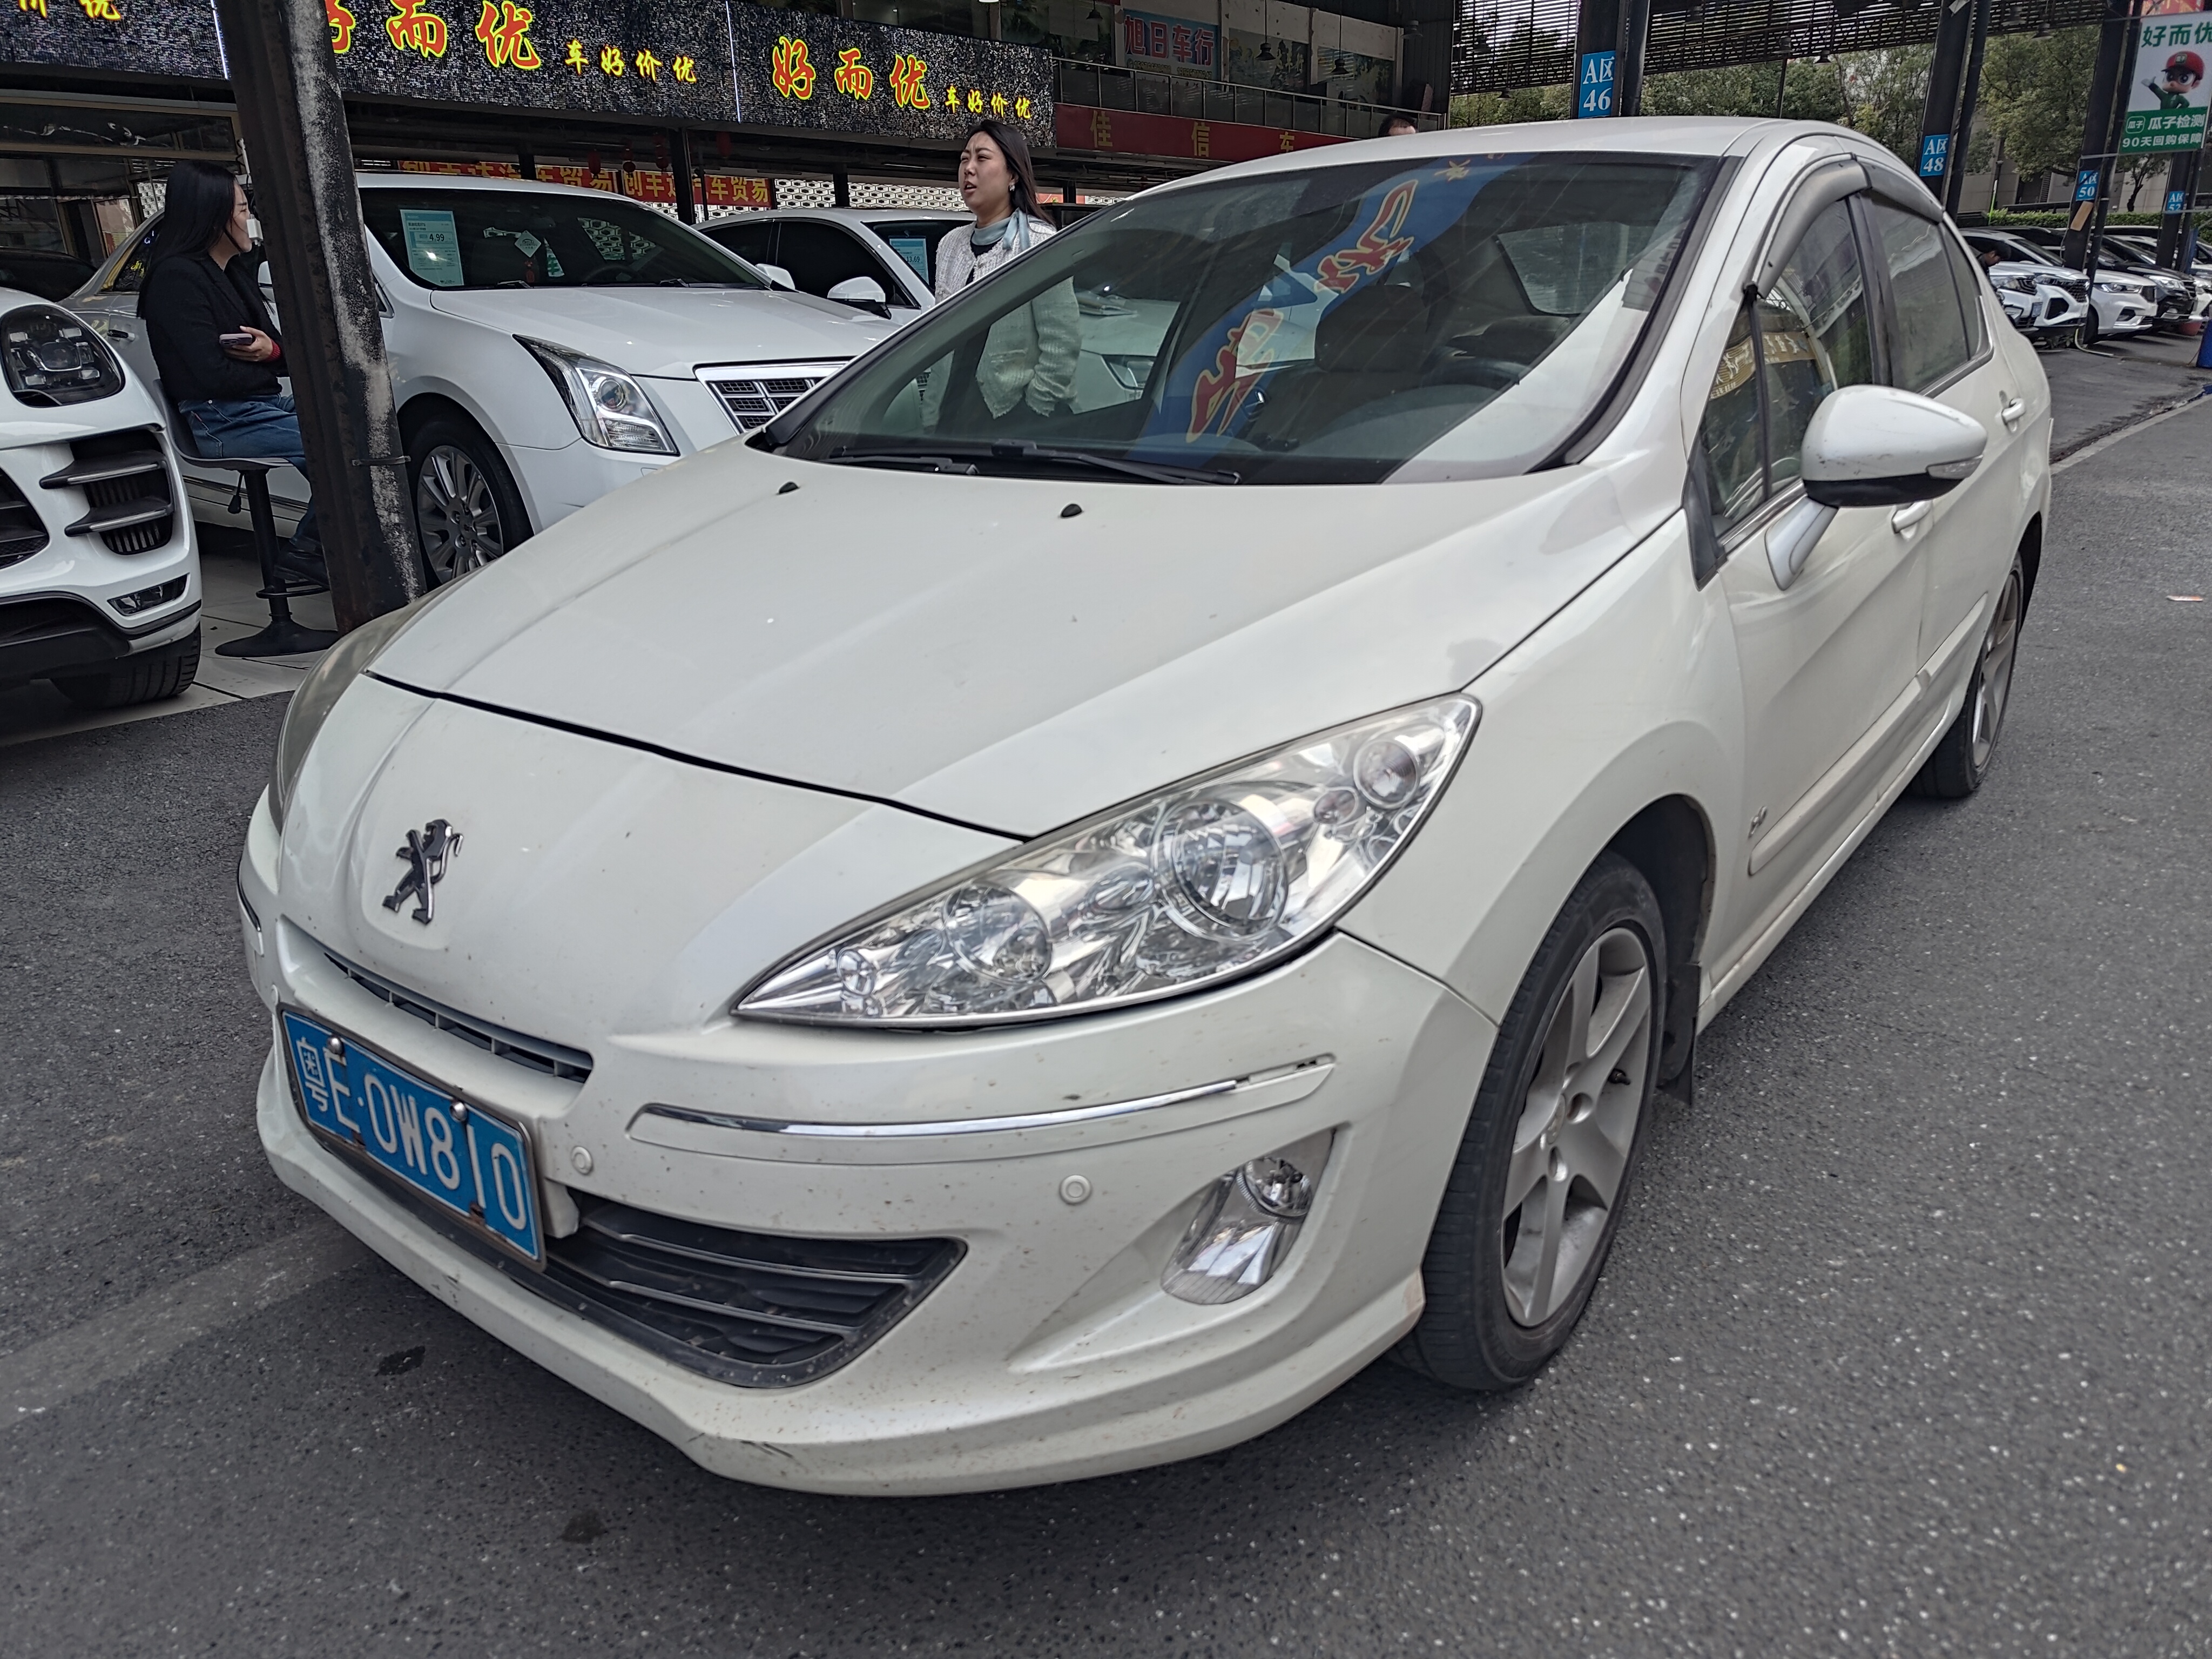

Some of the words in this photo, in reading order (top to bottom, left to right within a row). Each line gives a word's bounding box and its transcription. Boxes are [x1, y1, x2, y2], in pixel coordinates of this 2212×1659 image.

[1124, 15, 1215, 66] 旭日车行
[565, 39, 697, 82] 车好价优
[773, 36, 930, 109] 好而优
[945, 85, 1031, 119] 车好价优
[1582, 56, 1615, 84] A区
[1583, 87, 1611, 112] 46
[2127, 120, 2143, 129] 瓜子
[2147, 113, 2206, 130] 瓜子检测
[1923, 138, 1948, 155] A区
[2122, 132, 2202, 148] 90天回购保障
[1923, 157, 1944, 172] 48
[2080, 172, 2098, 185] A区
[2079, 186, 2095, 197] 50
[2168, 192, 2184, 203] A区
[2168, 203, 2181, 211] 52
[429, 233, 444, 241] 4.99
